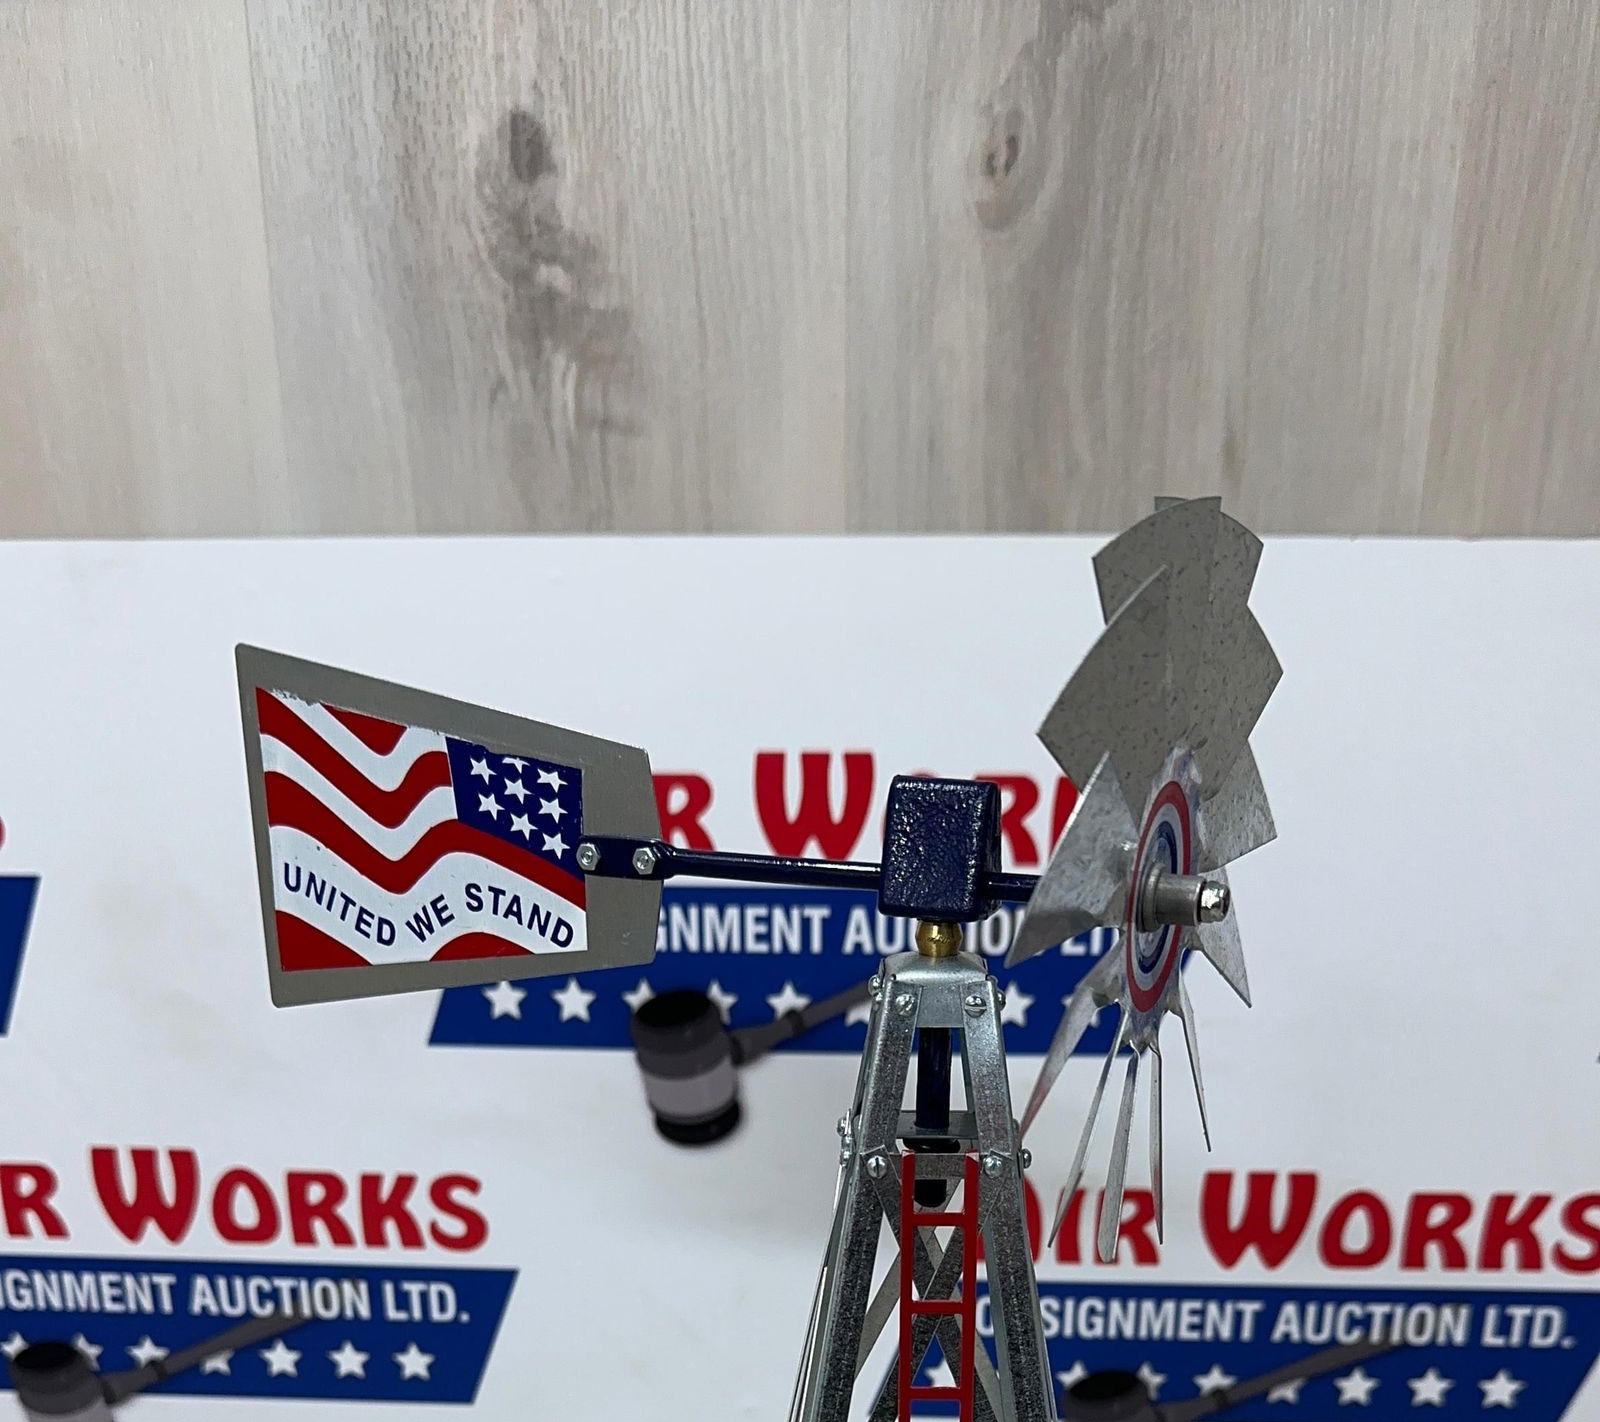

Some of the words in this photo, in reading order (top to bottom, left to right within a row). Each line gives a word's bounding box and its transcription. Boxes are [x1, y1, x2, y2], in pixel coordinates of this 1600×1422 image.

[284, 863, 396, 946] UNITED
[405, 894, 454, 943] WE
[464, 882, 574, 948] STAND
[88, 1145, 490, 1252] WORKS
[976, 1177, 1160, 1266] IR
[1201, 1170, 1600, 1275] WORKS
[190, 1275, 371, 1321] AUCTION
[382, 1281, 470, 1324] LTD.
[1270, 1300, 1472, 1347] AUCTION
[1480, 1304, 1576, 1349] LTD.
